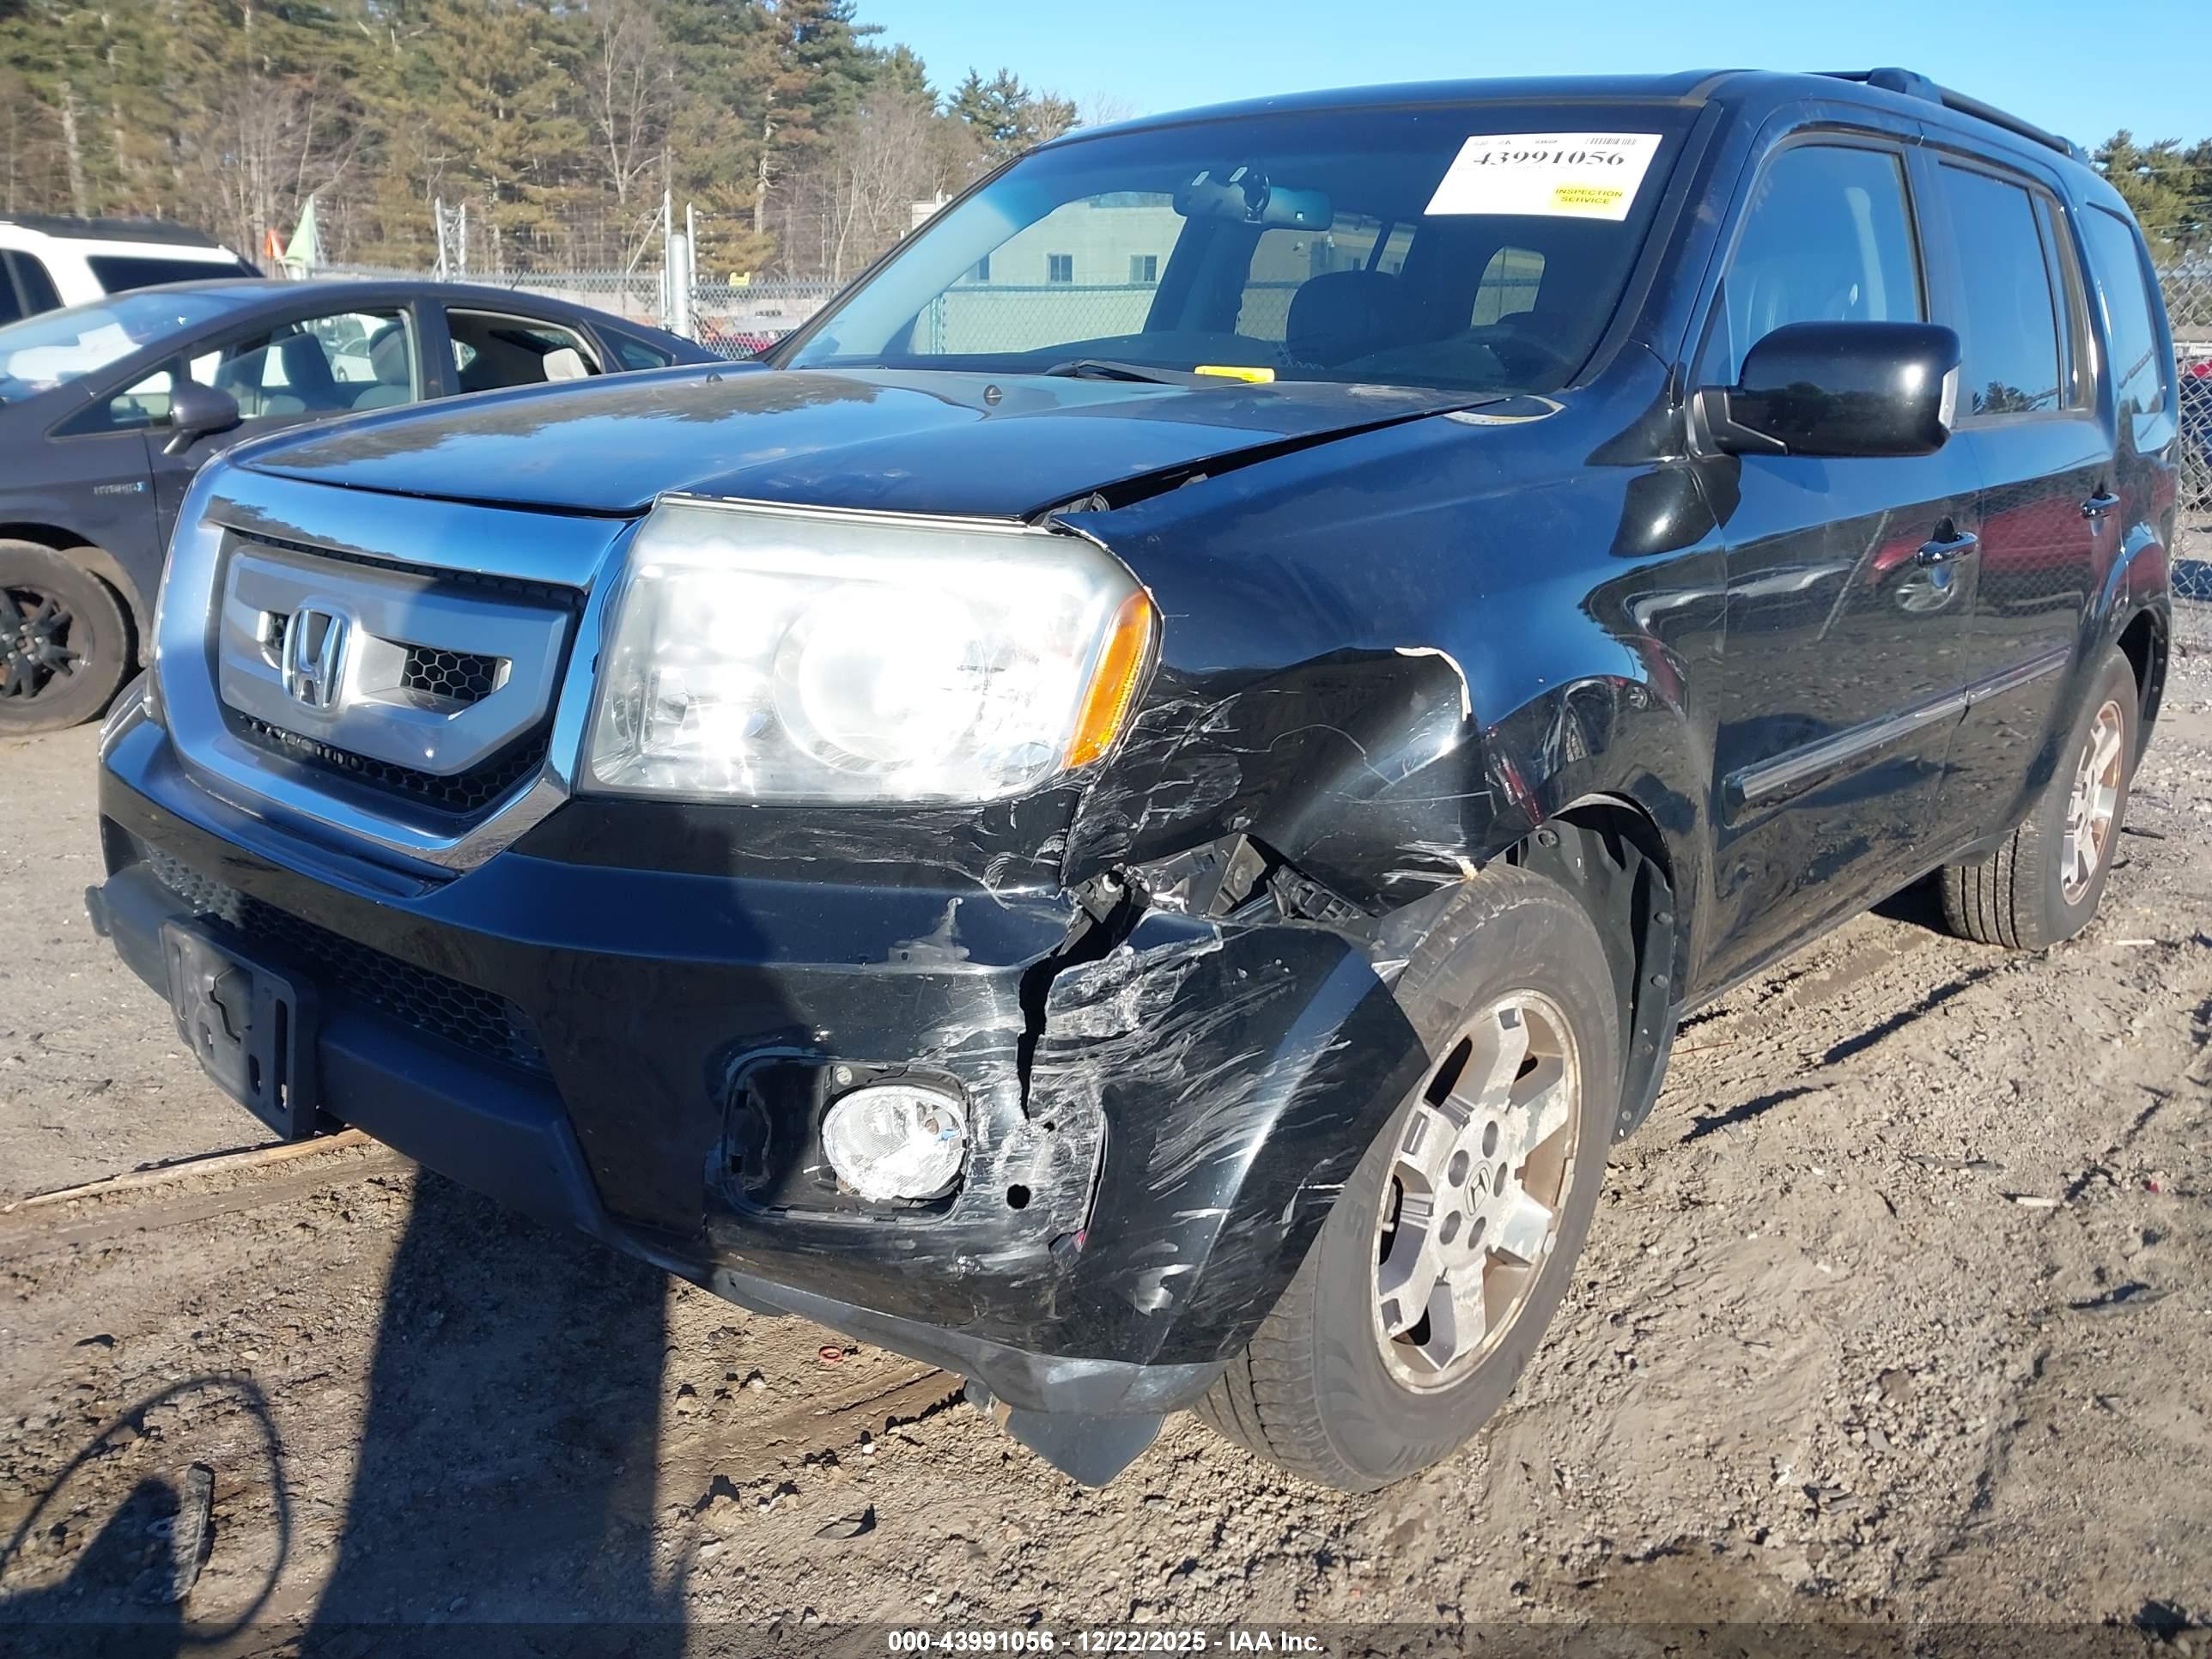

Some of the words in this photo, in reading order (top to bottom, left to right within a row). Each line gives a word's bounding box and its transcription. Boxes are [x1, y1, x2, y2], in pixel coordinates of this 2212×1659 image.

[1473, 150, 1626, 166] 43991056
[1555, 188, 1624, 198] INSPECTION
[1560, 196, 1611, 204] SERVICE
